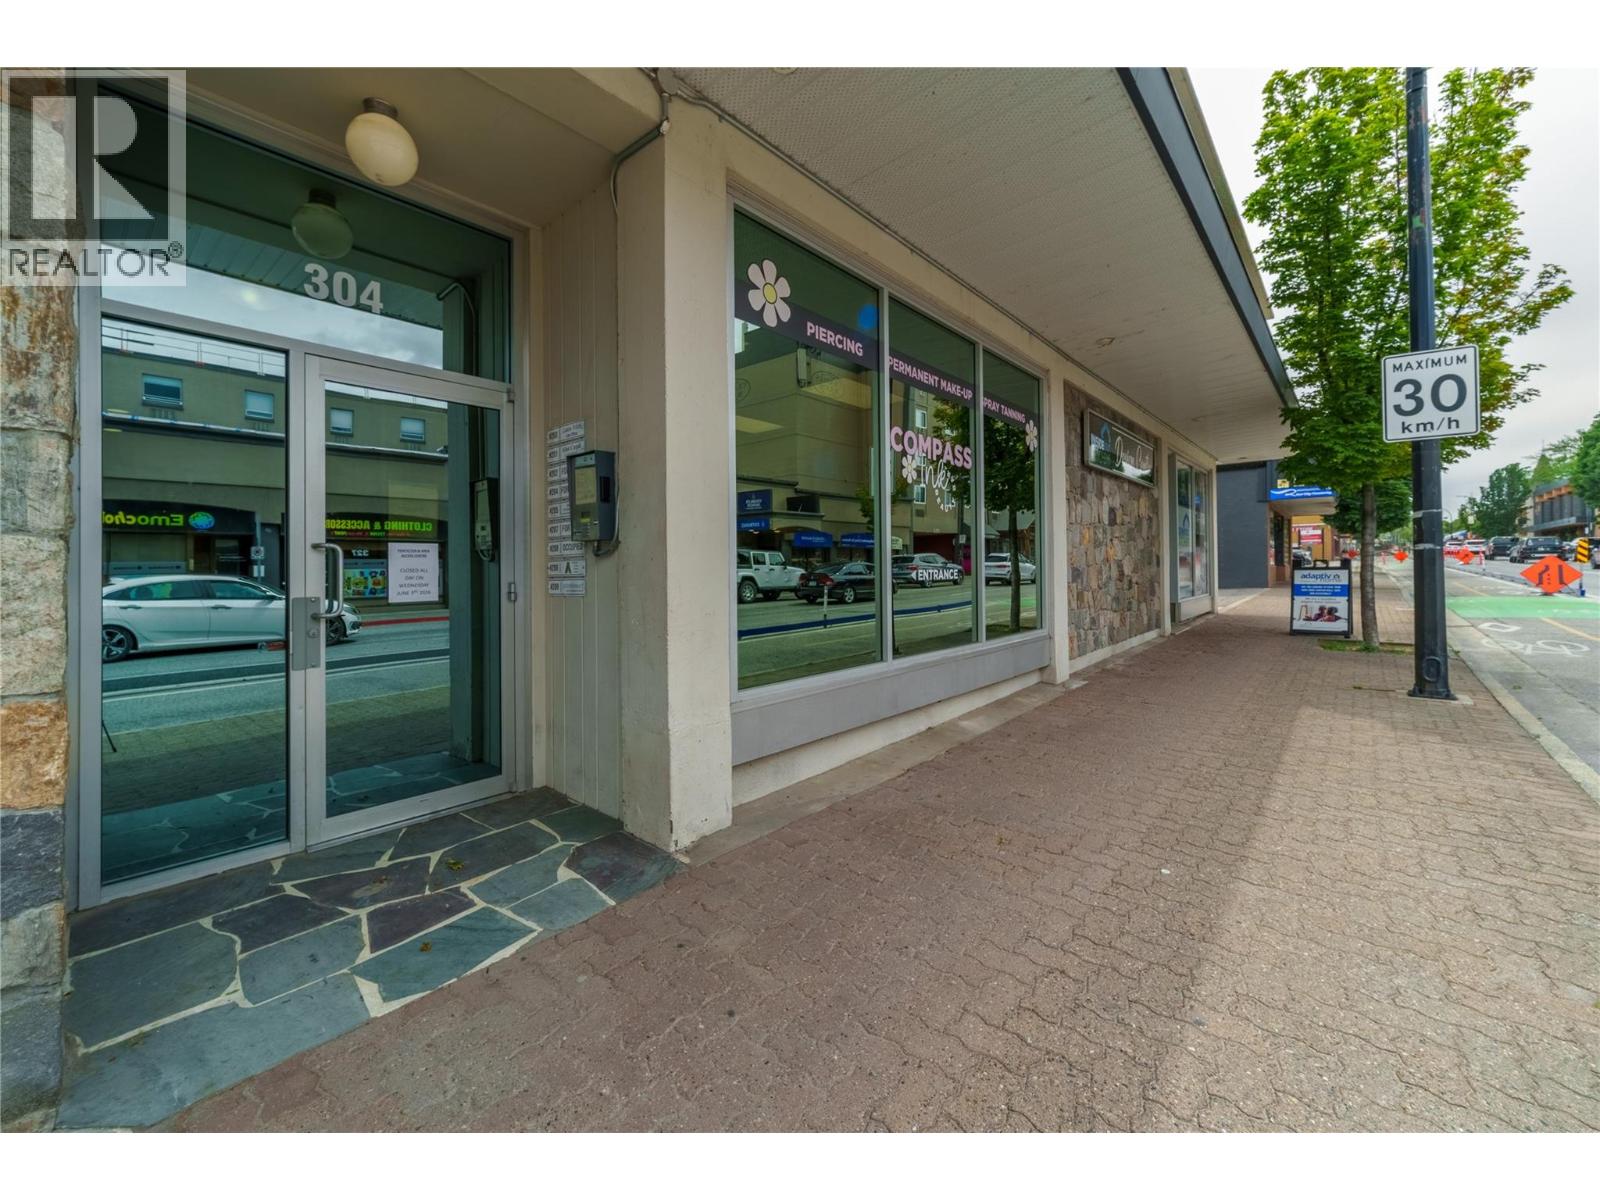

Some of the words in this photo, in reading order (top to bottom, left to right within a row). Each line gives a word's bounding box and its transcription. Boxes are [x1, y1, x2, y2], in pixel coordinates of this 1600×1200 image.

[303, 262, 384, 314] 304
[806, 321, 864, 357] PIERCING
[888, 356, 939, 388] PERMANENT
[940, 378, 973, 400] MAKE-UP
[1392, 354, 1468, 373] MAXIMUM
[983, 397, 1000, 413] PRAY
[1001, 404, 1026, 423] TANNING
[1392, 373, 1468, 417] 30
[1401, 416, 1460, 434] km/h
[890, 426, 973, 470] COMPASS
[917, 569, 960, 582] ENTRANCE
[1300, 572, 1332, 582] adaptiv
